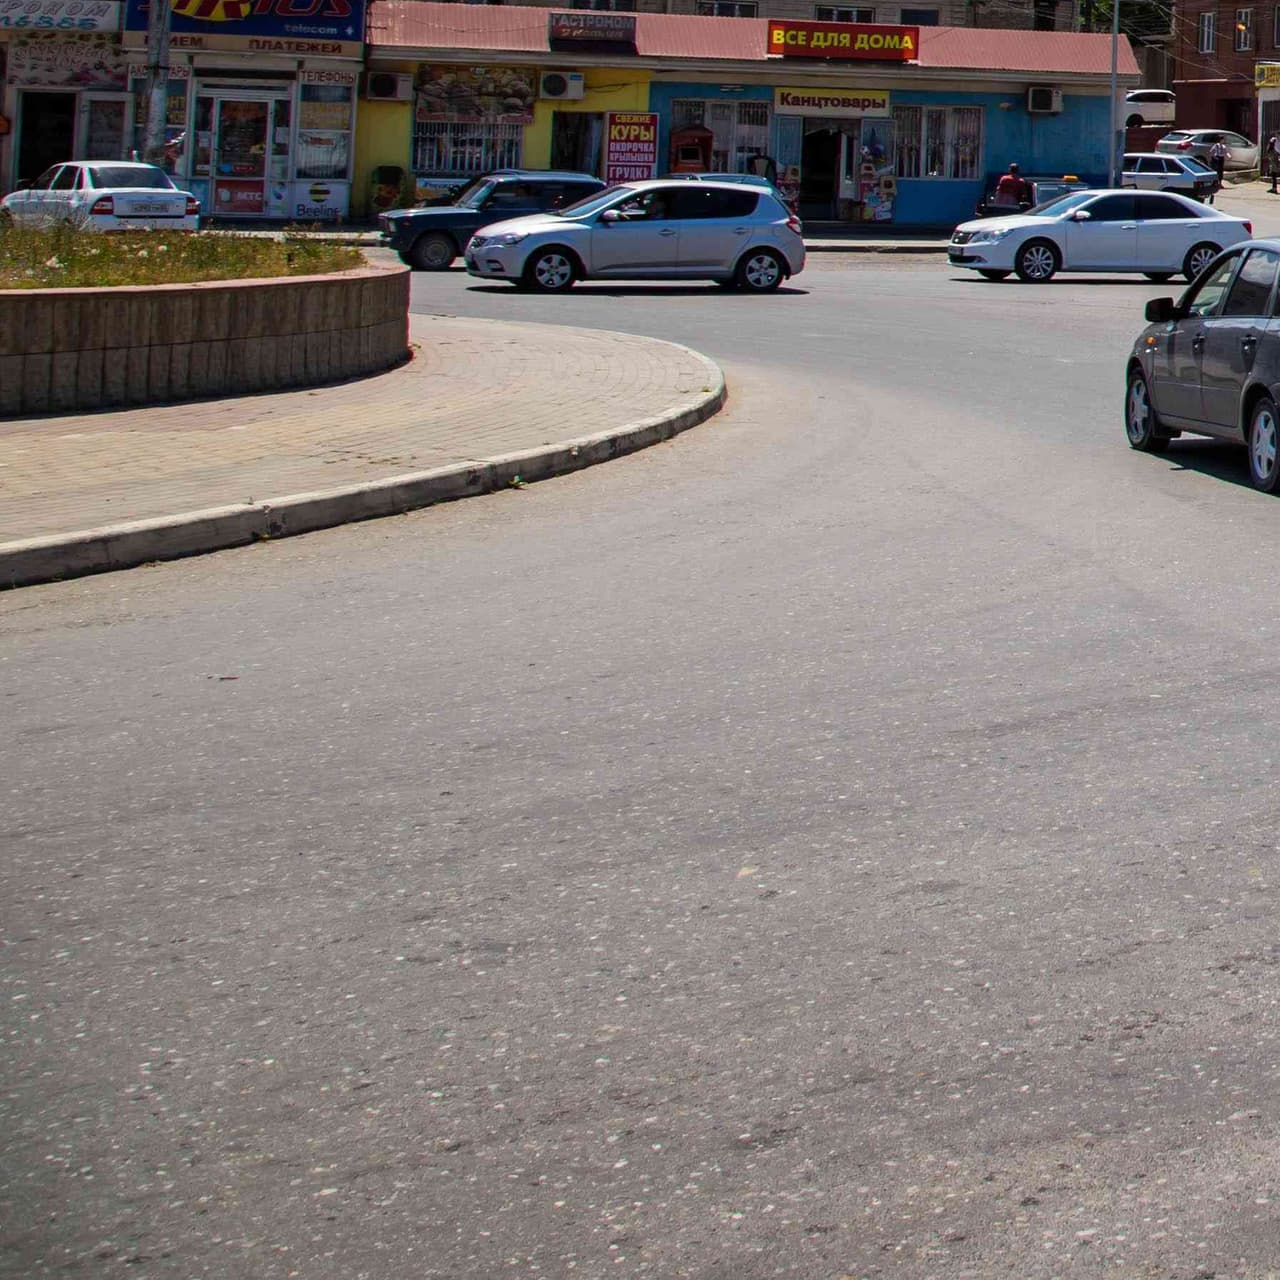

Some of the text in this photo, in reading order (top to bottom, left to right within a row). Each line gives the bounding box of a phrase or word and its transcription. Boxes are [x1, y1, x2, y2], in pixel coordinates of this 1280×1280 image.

[248, 39, 342, 54] ПЛАТЕЖЕЙ
[772, 29, 913, 51] ВСЕ ДЛЯ ДОМА
[300, 70, 356, 83] ТЕЛЕФОНЫ
[780, 92, 886, 111] Канцтовары
[610, 125, 655, 141] КУРЫ
